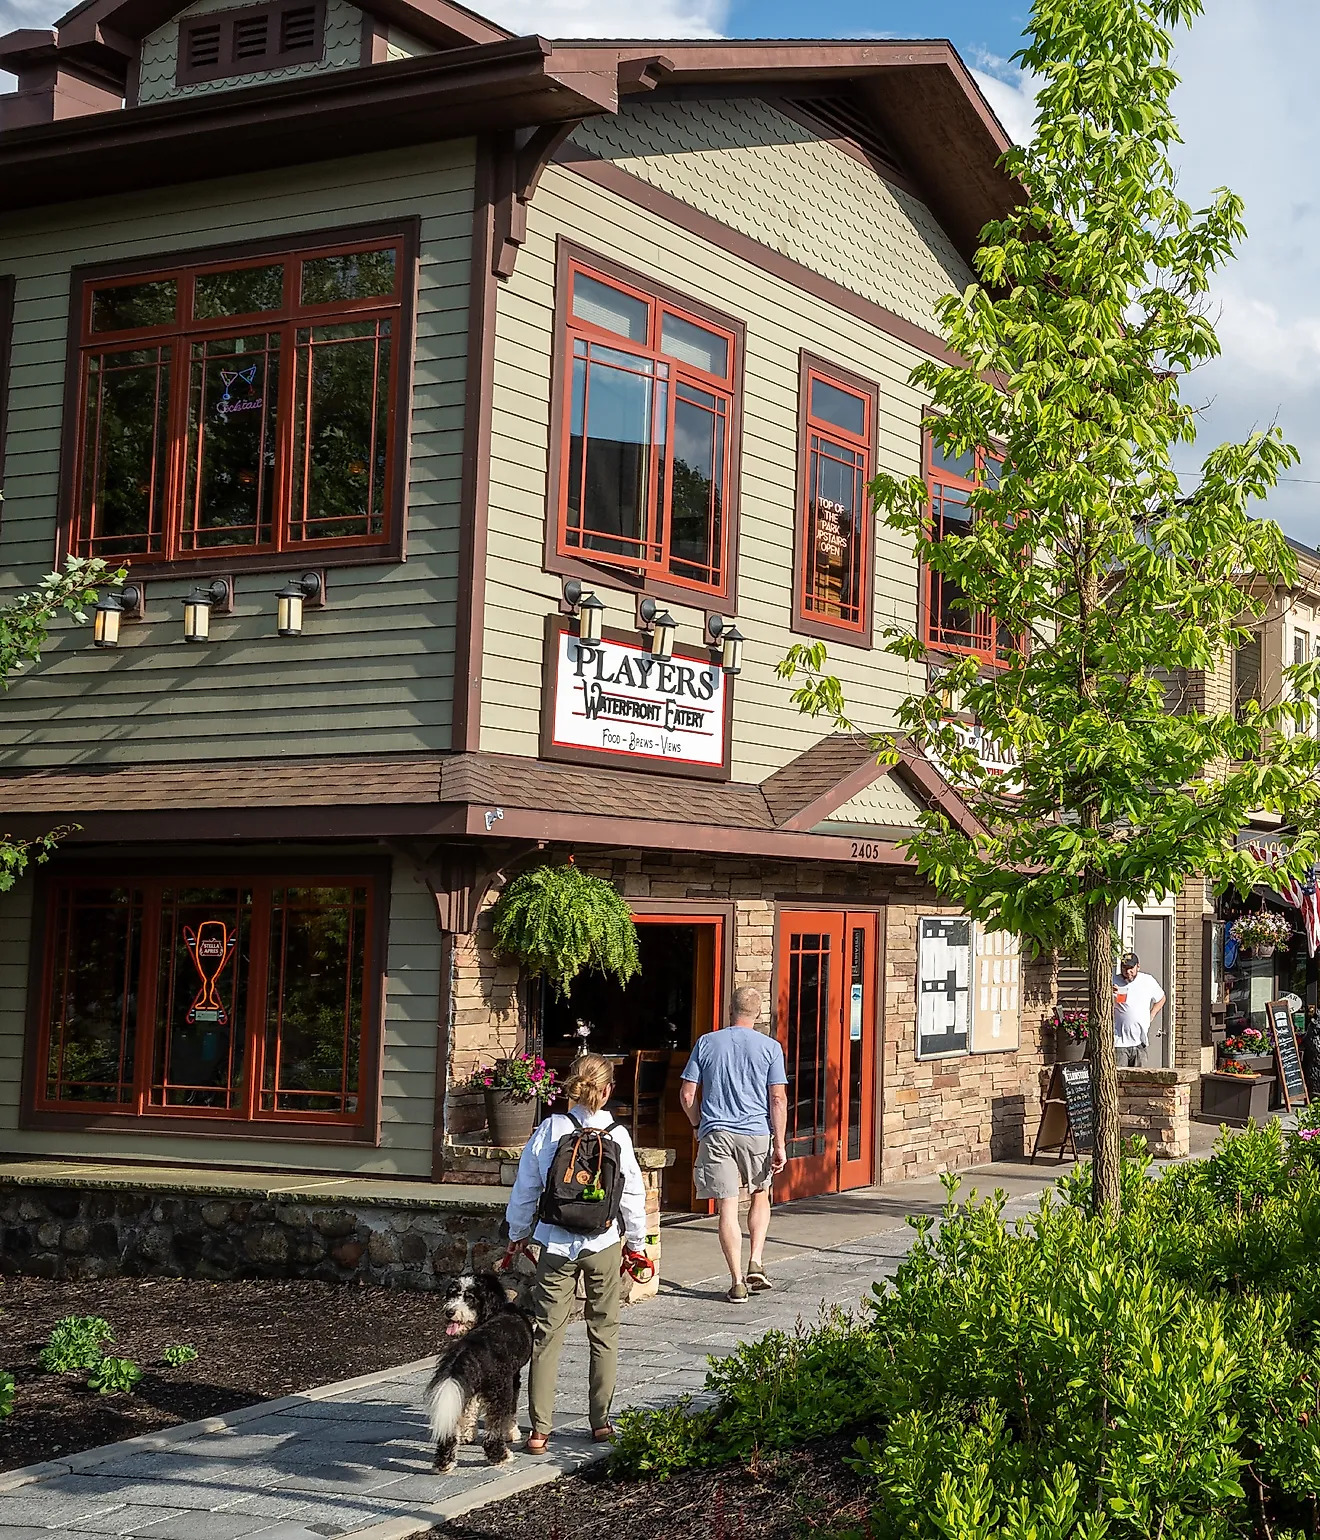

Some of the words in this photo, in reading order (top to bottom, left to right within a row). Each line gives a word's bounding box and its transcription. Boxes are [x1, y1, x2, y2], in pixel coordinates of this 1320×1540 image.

[818, 496, 833, 510] TOP
[834, 503, 845, 514] OF
[825, 510, 839, 524] THE
[821, 520, 840, 535] PARK
[820, 541, 840, 556] OPEN
[573, 645, 714, 700] PLAYERS
[980, 735, 1017, 765] PARK
[851, 842, 879, 859] 2405
